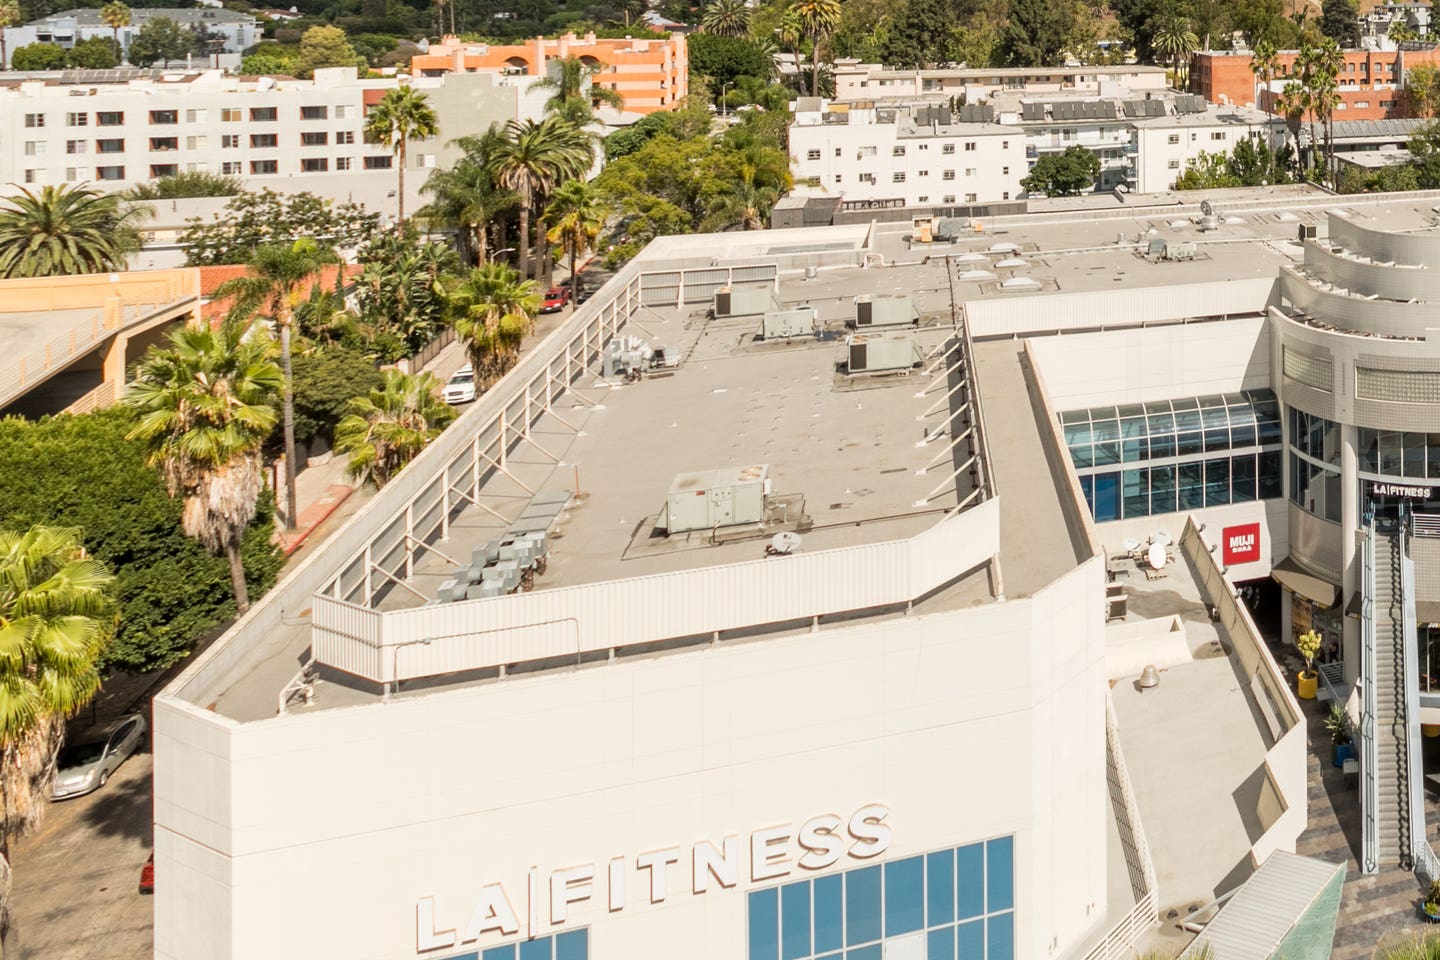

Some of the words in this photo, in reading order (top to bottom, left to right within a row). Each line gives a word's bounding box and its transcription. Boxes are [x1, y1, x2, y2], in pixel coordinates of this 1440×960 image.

[1373, 484, 1386, 495] LA
[1390, 486, 1431, 498] FITNESS
[1229, 534, 1254, 548] MUJI
[417, 881, 520, 954] LA
[550, 803, 893, 925] FITNESS
